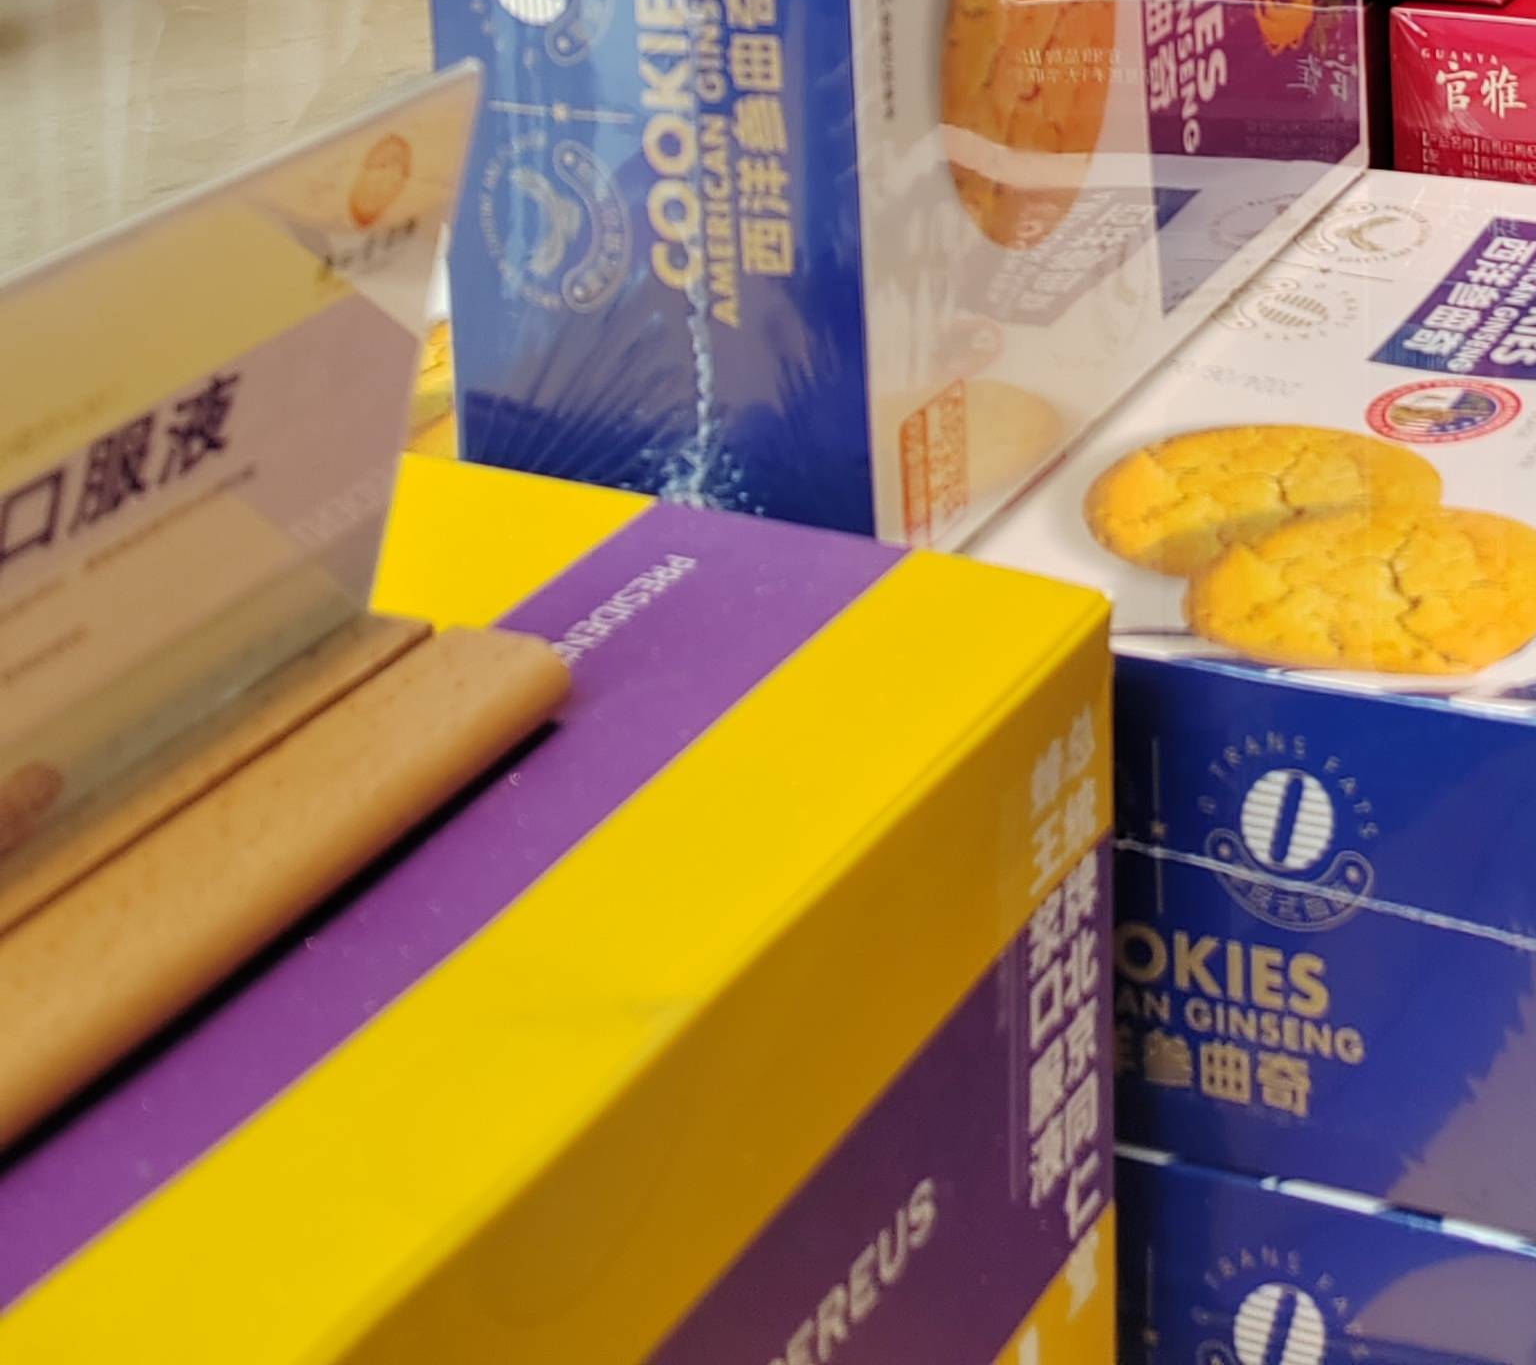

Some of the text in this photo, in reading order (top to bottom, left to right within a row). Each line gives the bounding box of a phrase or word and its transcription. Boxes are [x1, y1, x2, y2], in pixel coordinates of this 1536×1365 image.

[1435, 59, 1529, 119] 官雅
[701, 112, 741, 329] AMERICAN
[1447, 302, 1518, 373] GINSENG
[0, 372, 240, 569] 口服液
[1113, 922, 1331, 1019] OKIES
[1115, 1021, 1314, 1119] 参曲奇
[1184, 996, 1367, 1066] GINSENG
[769, 1176, 936, 1365] EREUS
